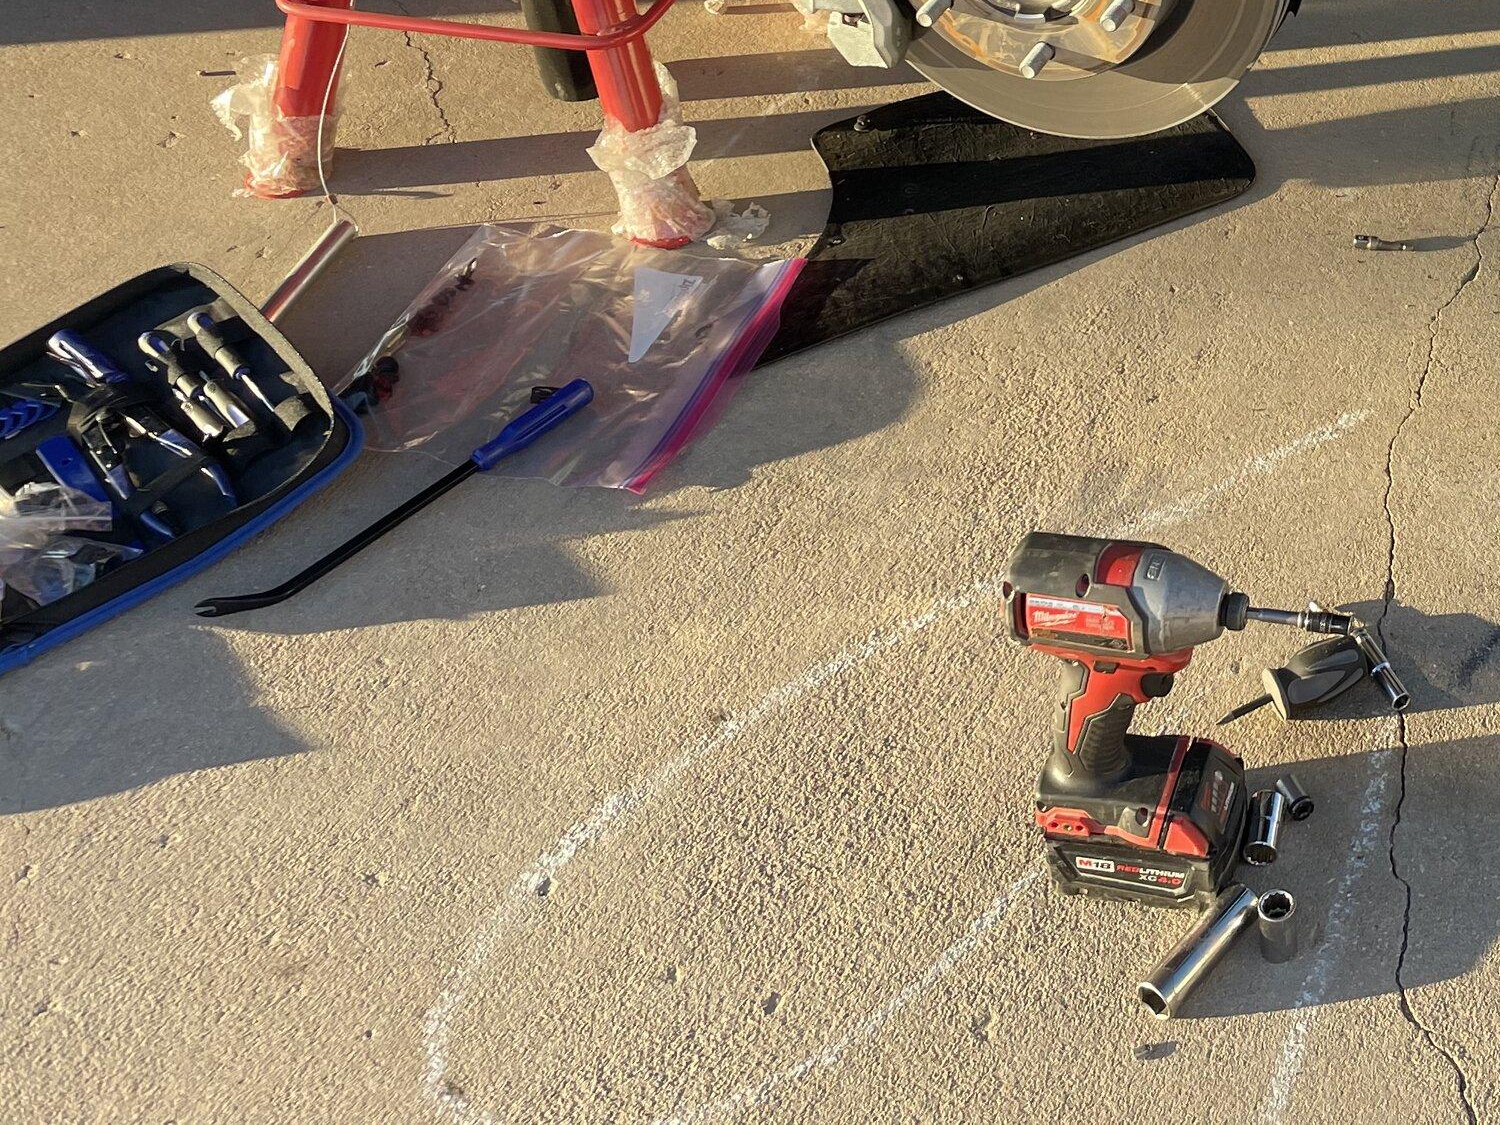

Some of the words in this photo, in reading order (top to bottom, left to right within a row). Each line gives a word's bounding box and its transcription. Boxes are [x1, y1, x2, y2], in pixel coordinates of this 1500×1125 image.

[1078, 859, 1112, 870] M18
[1116, 863, 1185, 879] REDLITHIUM
[1138, 874, 1158, 882] XC
